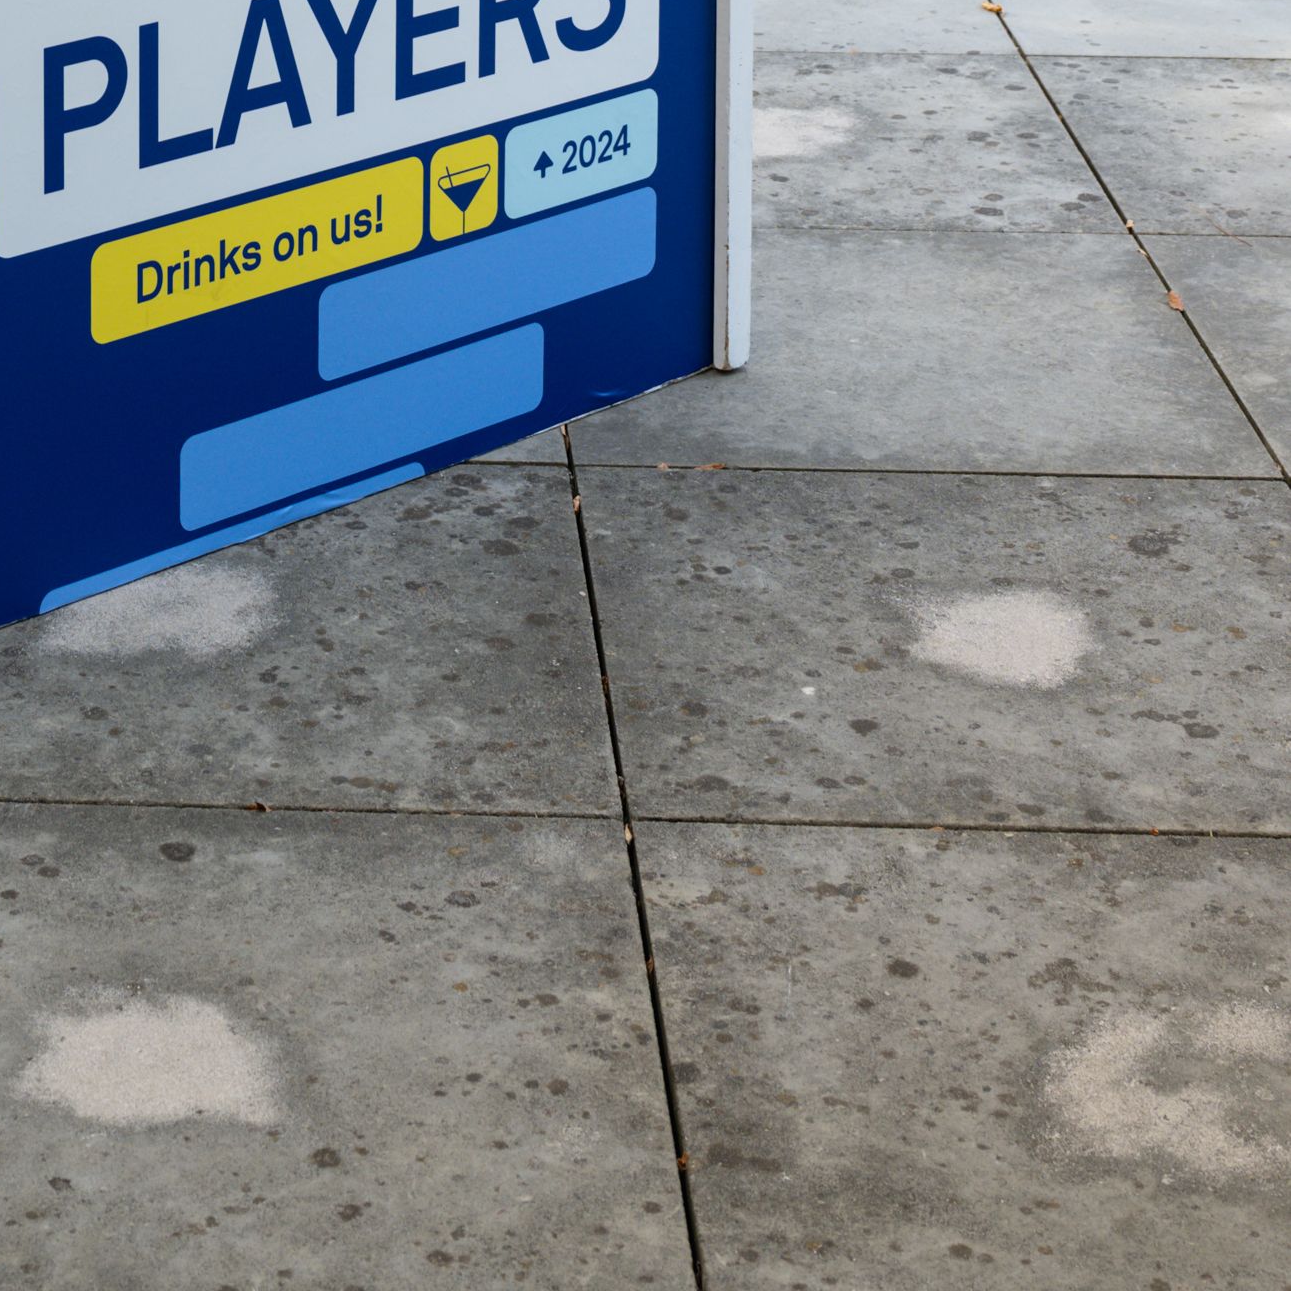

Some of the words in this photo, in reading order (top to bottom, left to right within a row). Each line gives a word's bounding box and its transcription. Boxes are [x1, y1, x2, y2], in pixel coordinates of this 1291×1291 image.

[561, 124, 632, 176] 2024
[136, 239, 262, 305] Drinks
[273, 224, 317, 262] on
[329, 195, 384, 246] us!
